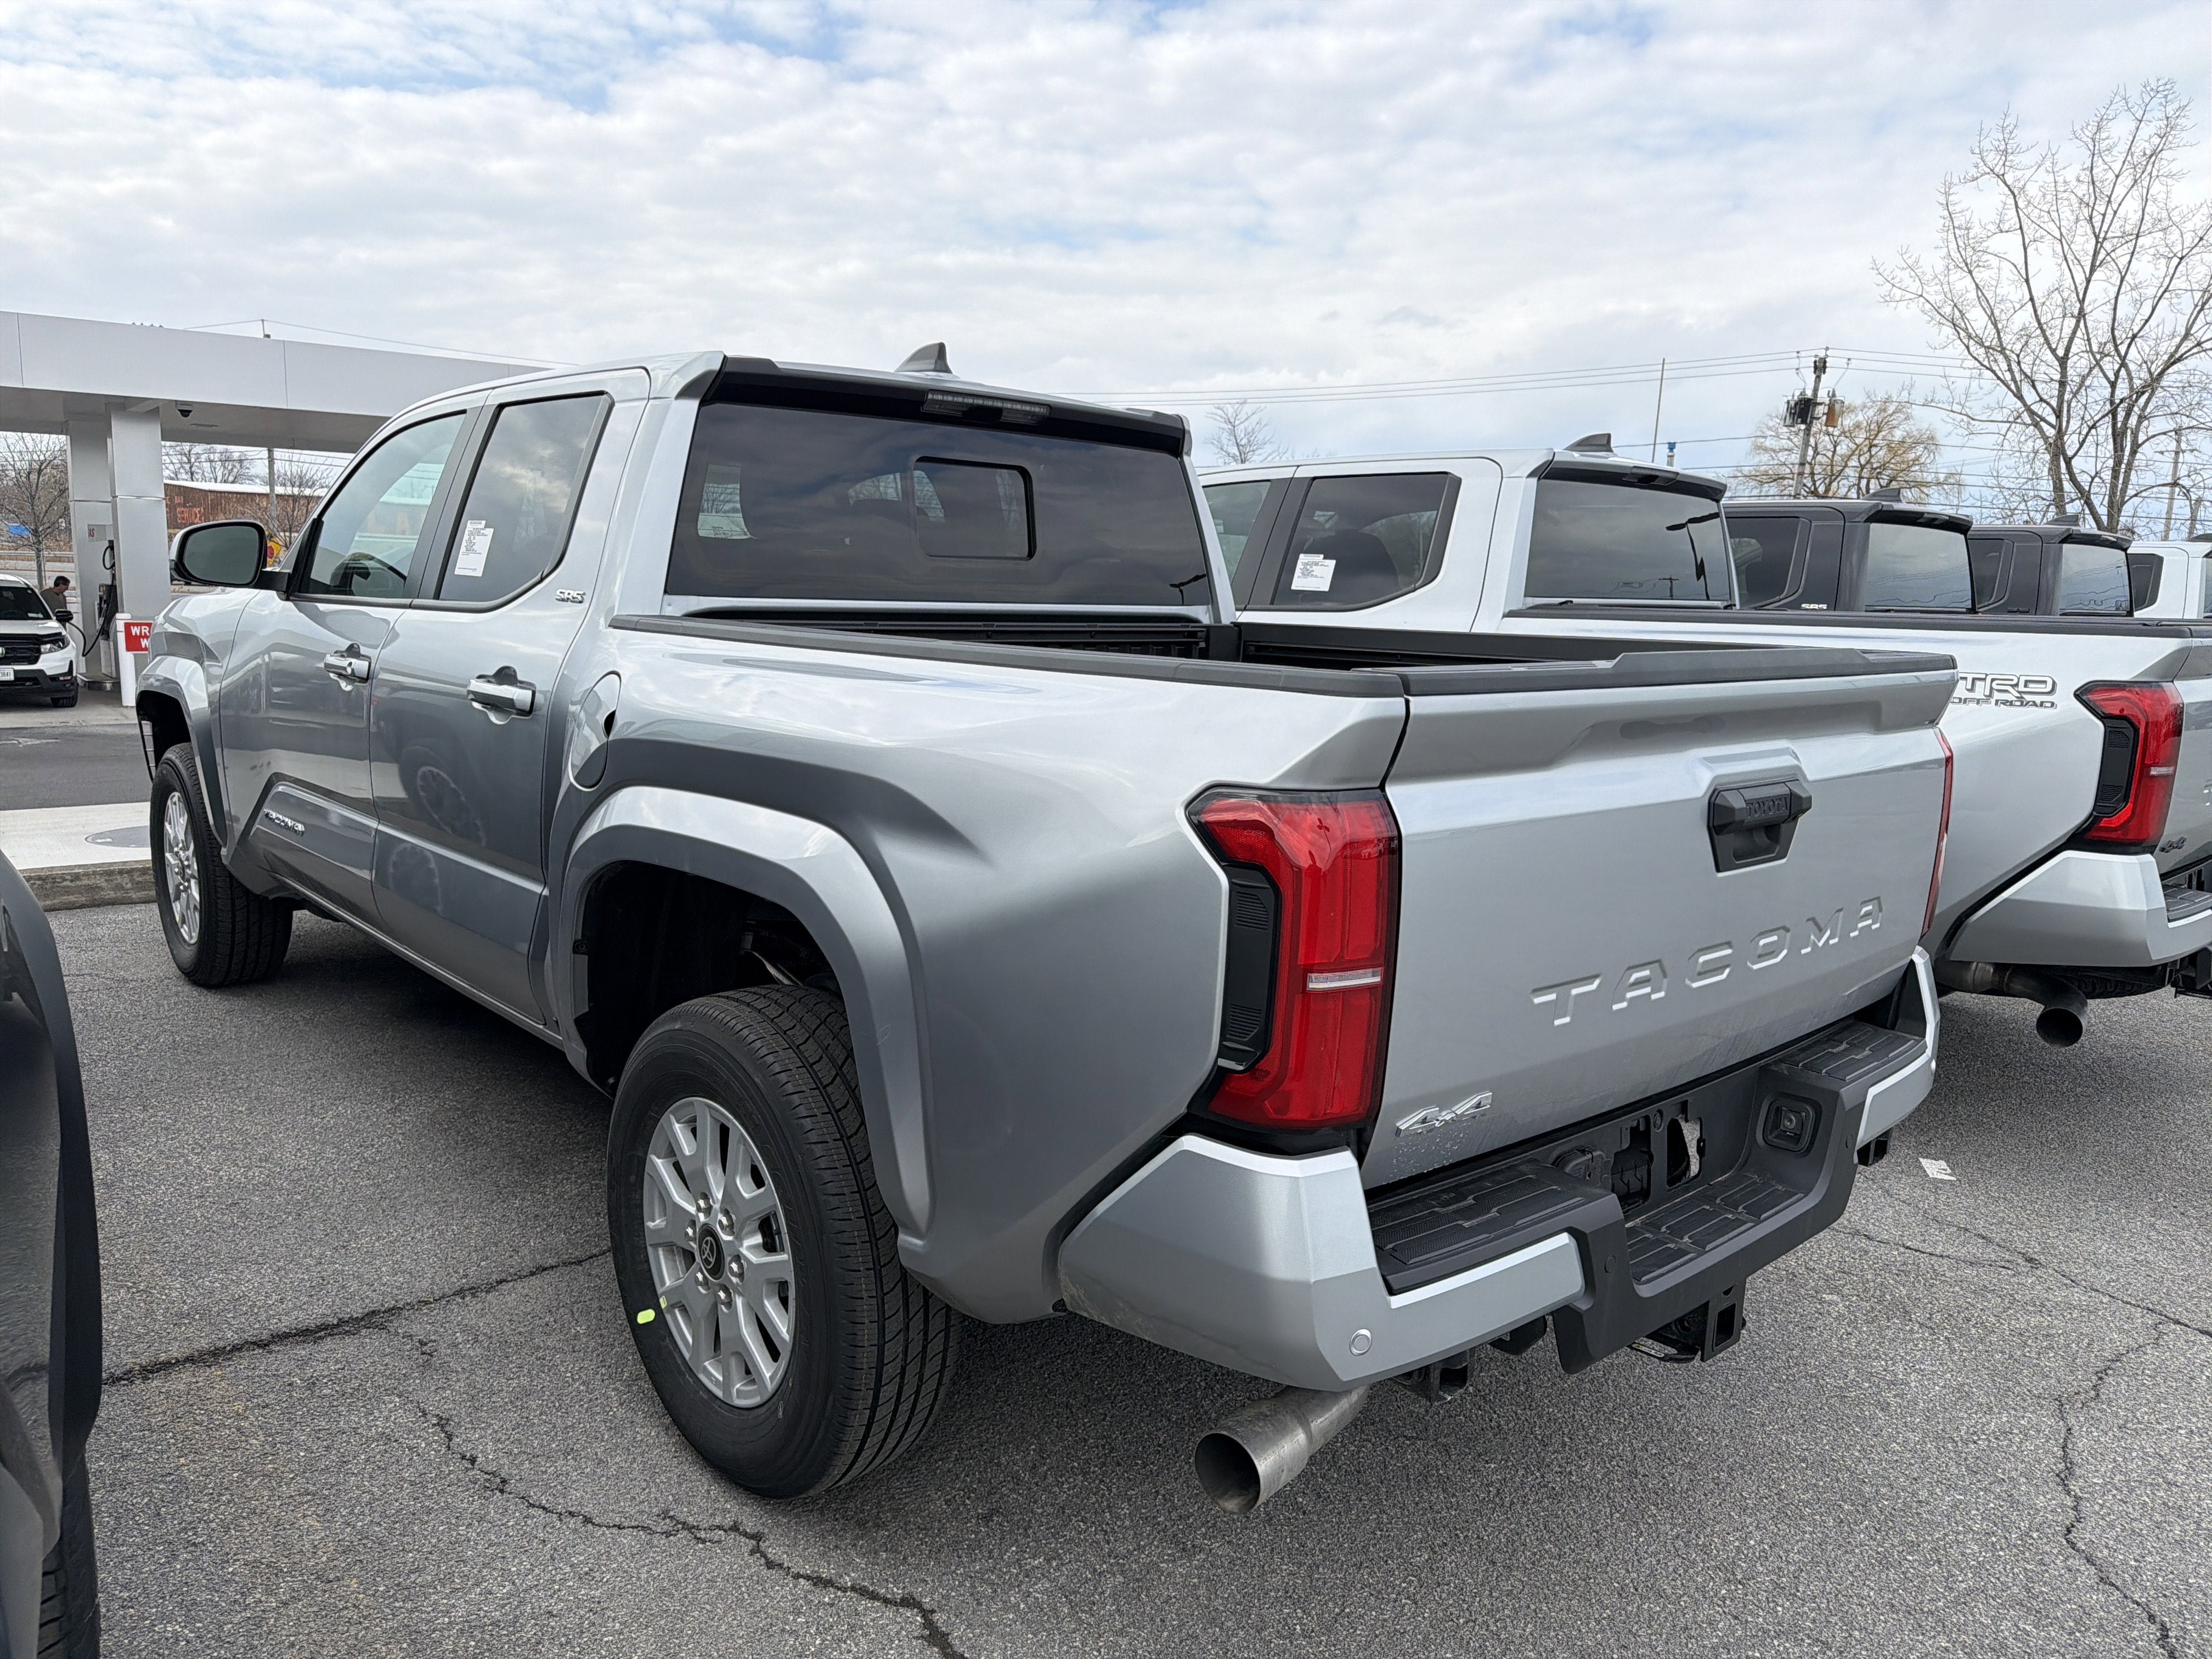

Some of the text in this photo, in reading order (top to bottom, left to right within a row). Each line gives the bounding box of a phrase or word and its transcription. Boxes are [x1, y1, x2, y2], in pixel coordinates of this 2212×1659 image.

[555, 589, 585, 603] SR5
[1959, 672, 2057, 699] TRD
[1950, 697, 2057, 710] OFF ROAD
[1746, 797, 1788, 818] TOYOTA
[1531, 895, 1884, 1026] TACOMA
[1395, 1091, 1493, 1137] 4x4
